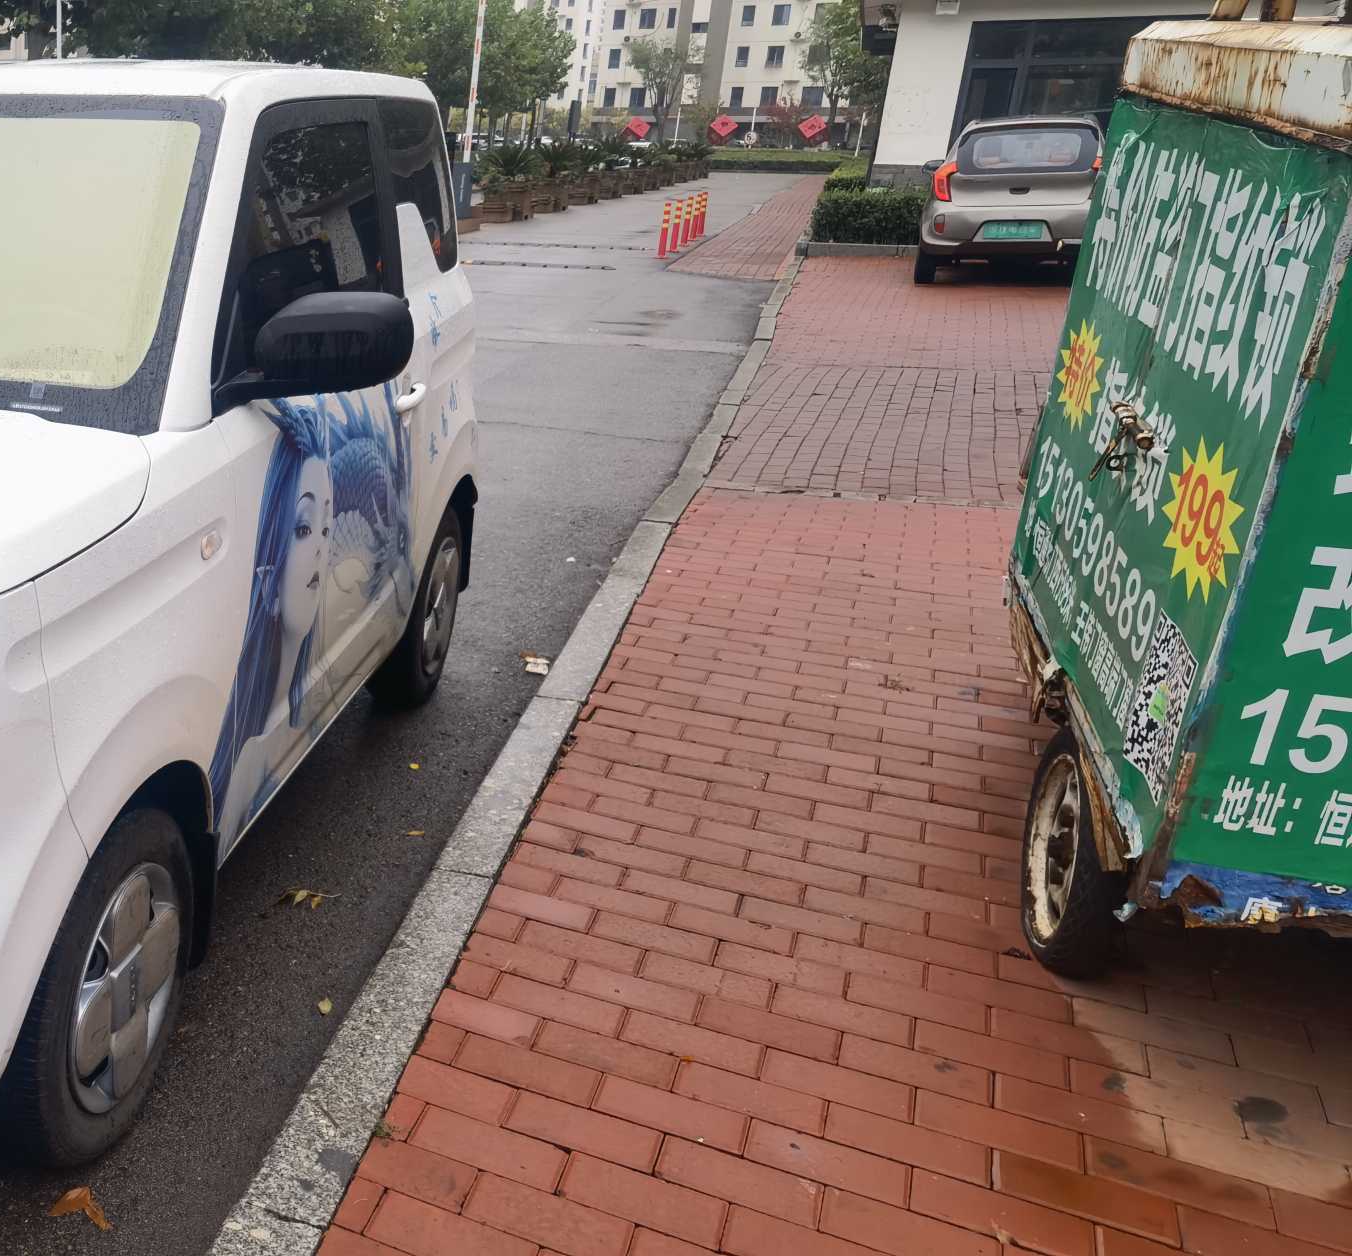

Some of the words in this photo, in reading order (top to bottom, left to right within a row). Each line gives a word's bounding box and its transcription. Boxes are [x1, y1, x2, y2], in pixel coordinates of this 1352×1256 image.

[1065, 336, 1096, 408] 特价
[1086, 136, 1326, 433] 特价防盗门指纹锁
[1036, 435, 1156, 662] 15130598589
